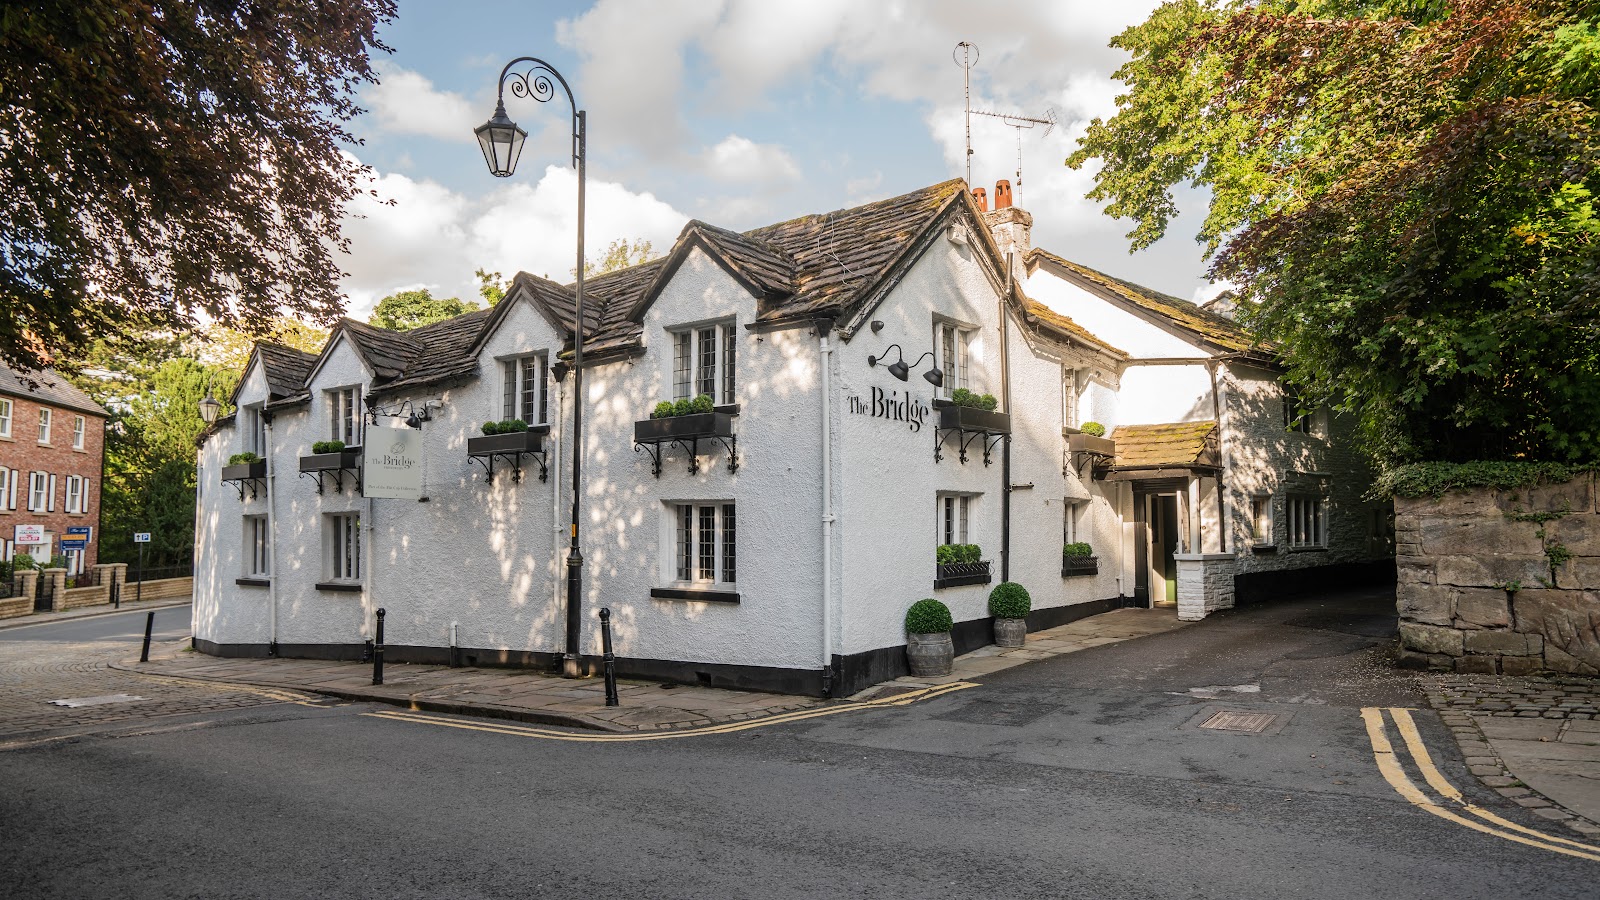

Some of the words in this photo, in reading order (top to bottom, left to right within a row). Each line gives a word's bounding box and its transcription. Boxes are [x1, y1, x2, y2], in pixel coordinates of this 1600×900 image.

[847, 396, 868, 415] The
[871, 386, 929, 432] Bridge
[384, 455, 416, 469] Bridge
